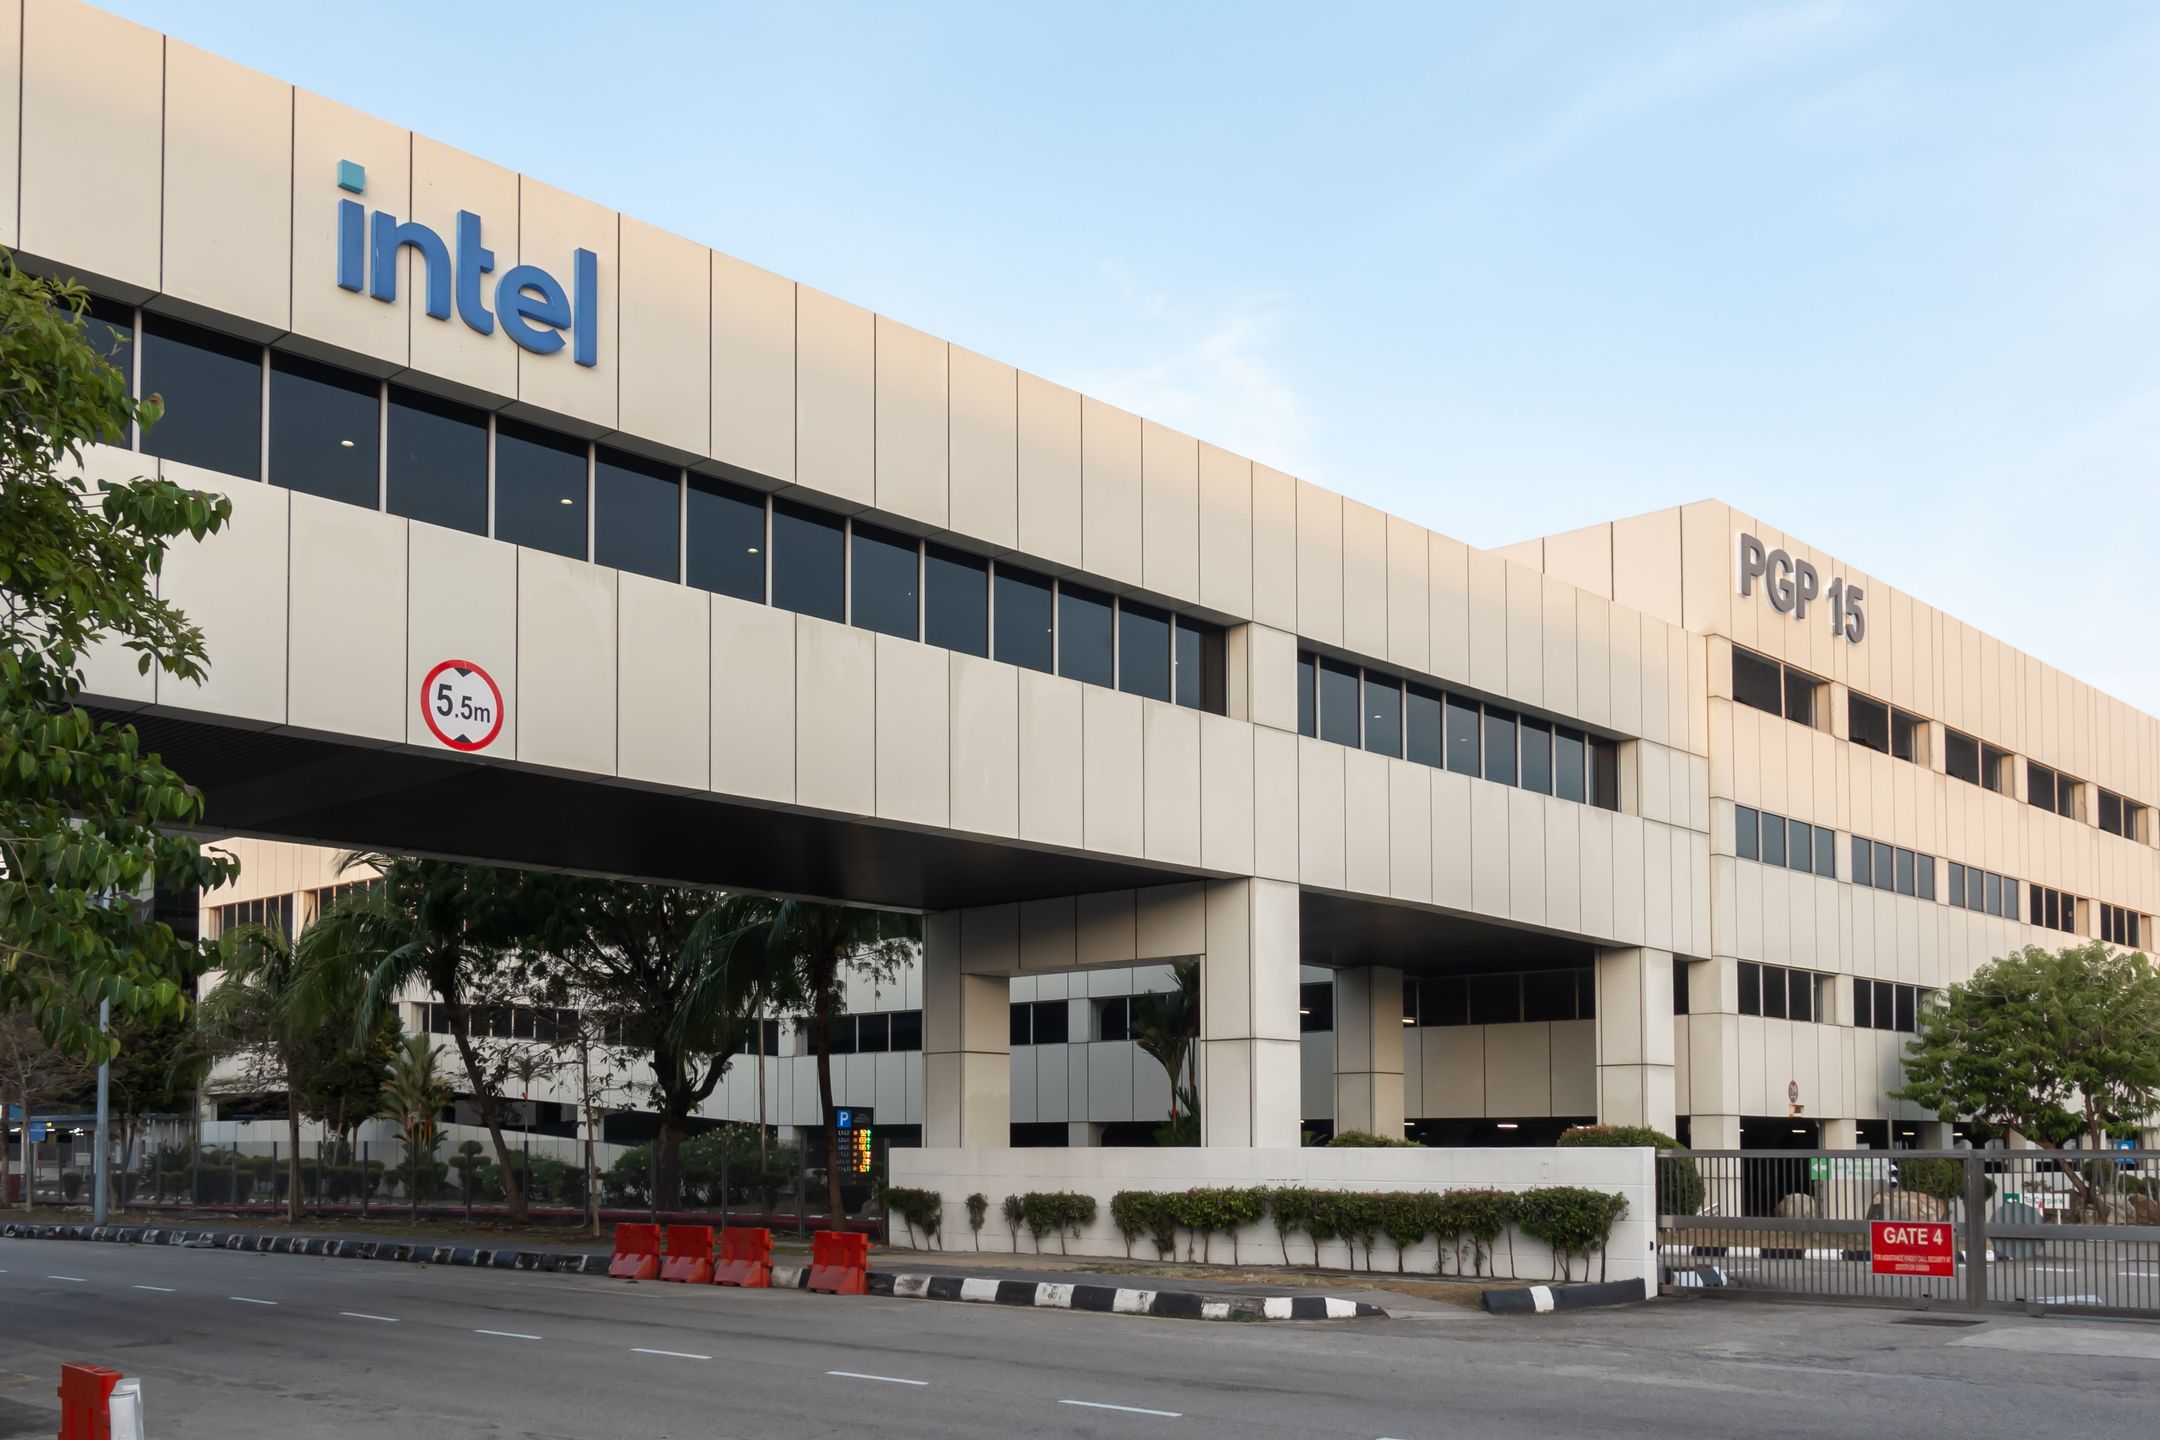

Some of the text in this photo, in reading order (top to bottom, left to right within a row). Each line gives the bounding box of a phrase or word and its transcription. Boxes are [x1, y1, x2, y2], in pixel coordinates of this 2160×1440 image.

[337, 159, 598, 368] intel
[1740, 532, 1866, 644] PGP 15
[436, 683, 491, 724] 5.5m
[1883, 1226, 1943, 1245] GATE 4
